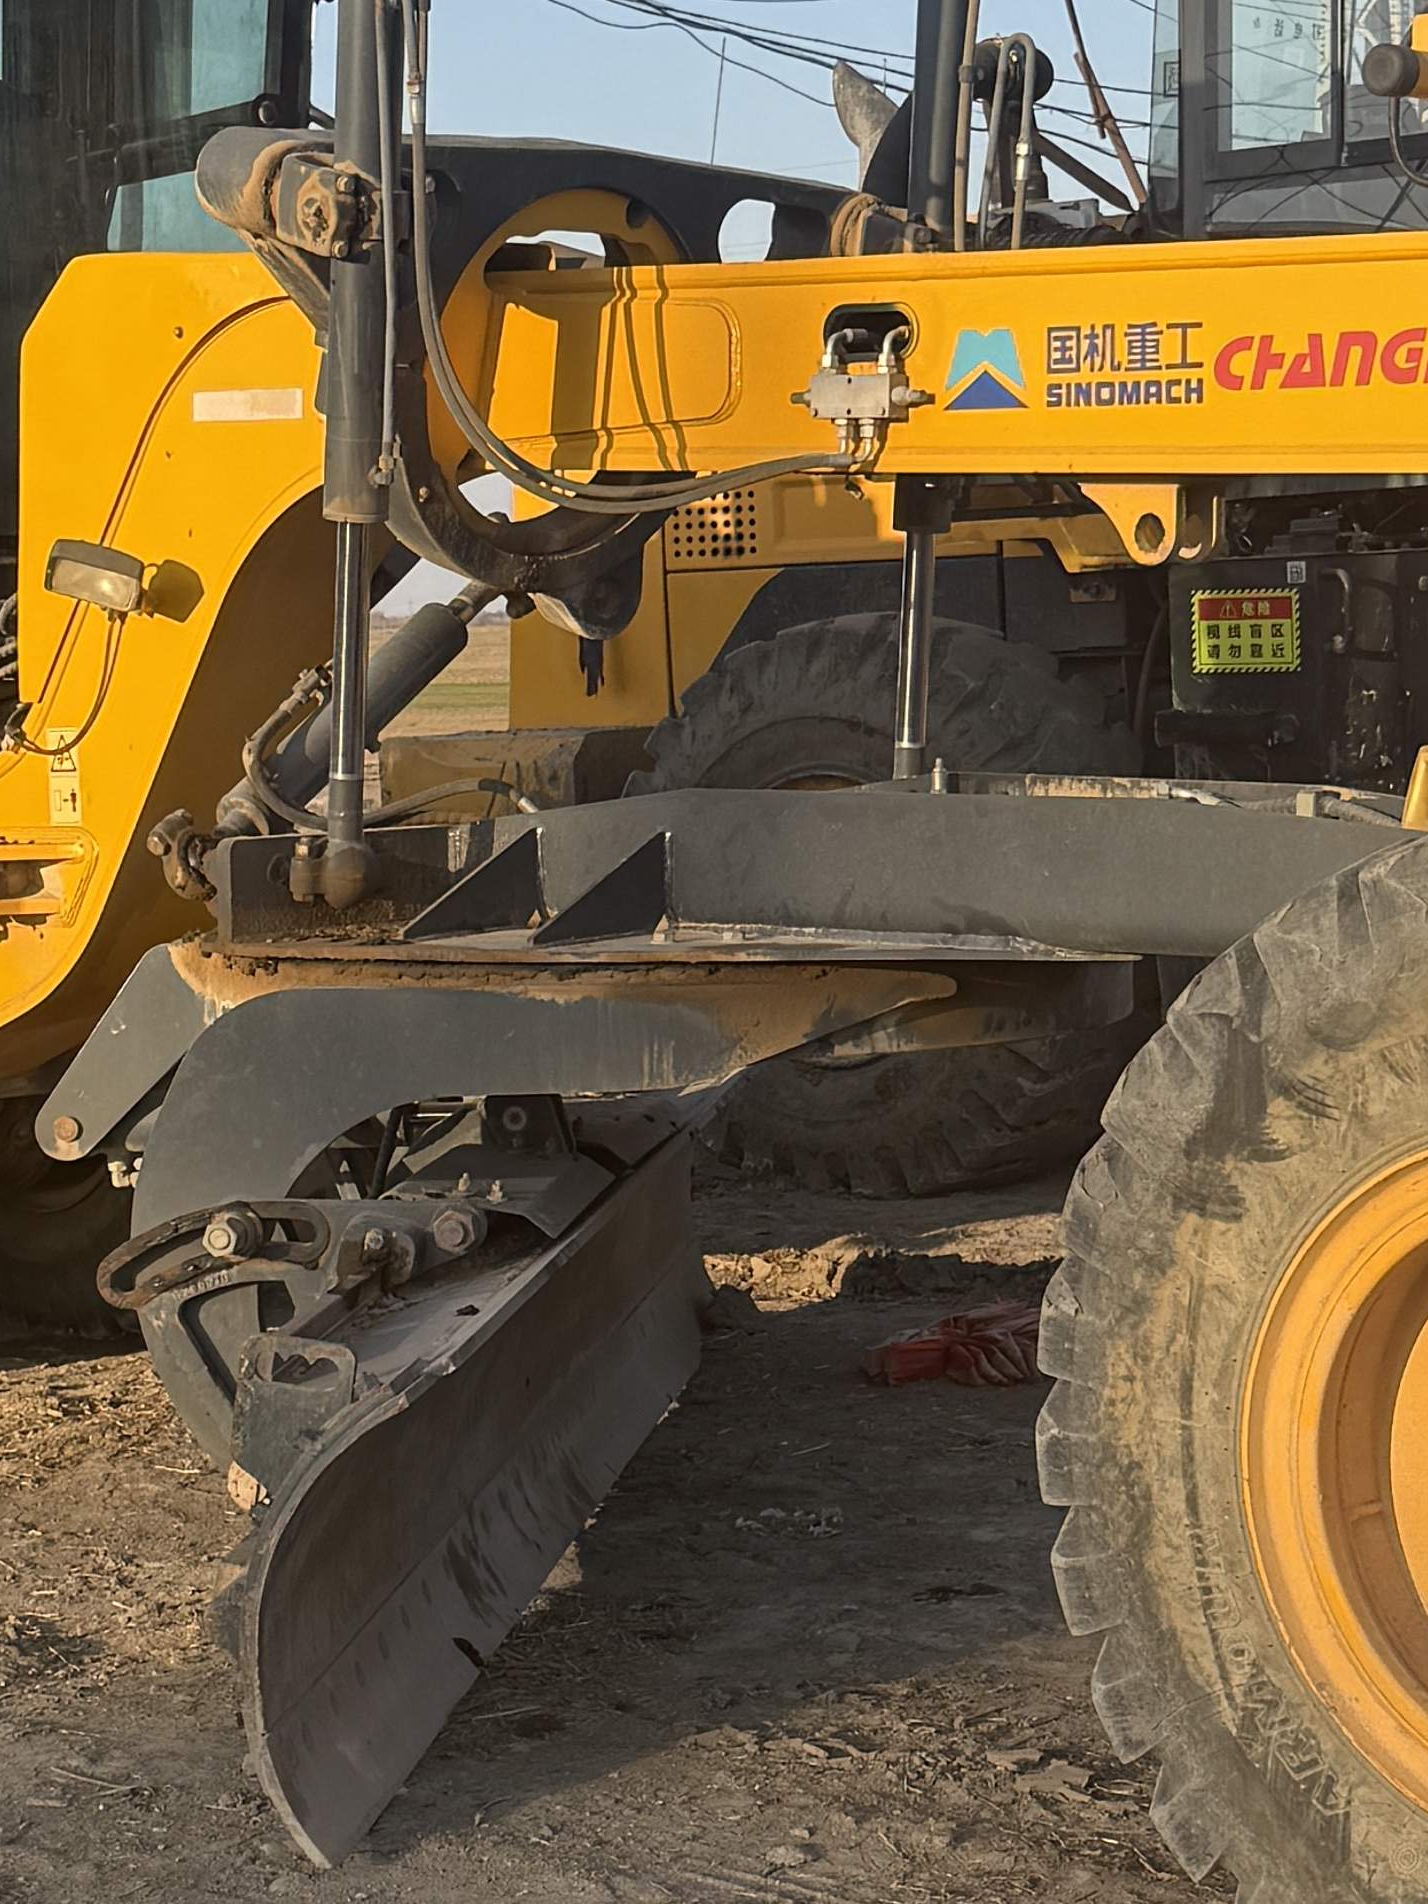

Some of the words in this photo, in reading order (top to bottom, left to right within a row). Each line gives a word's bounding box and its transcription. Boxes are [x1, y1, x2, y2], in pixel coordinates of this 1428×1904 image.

[1047, 322, 1204, 374] 国机重工
[1046, 377, 1204, 408] SINOMACH
